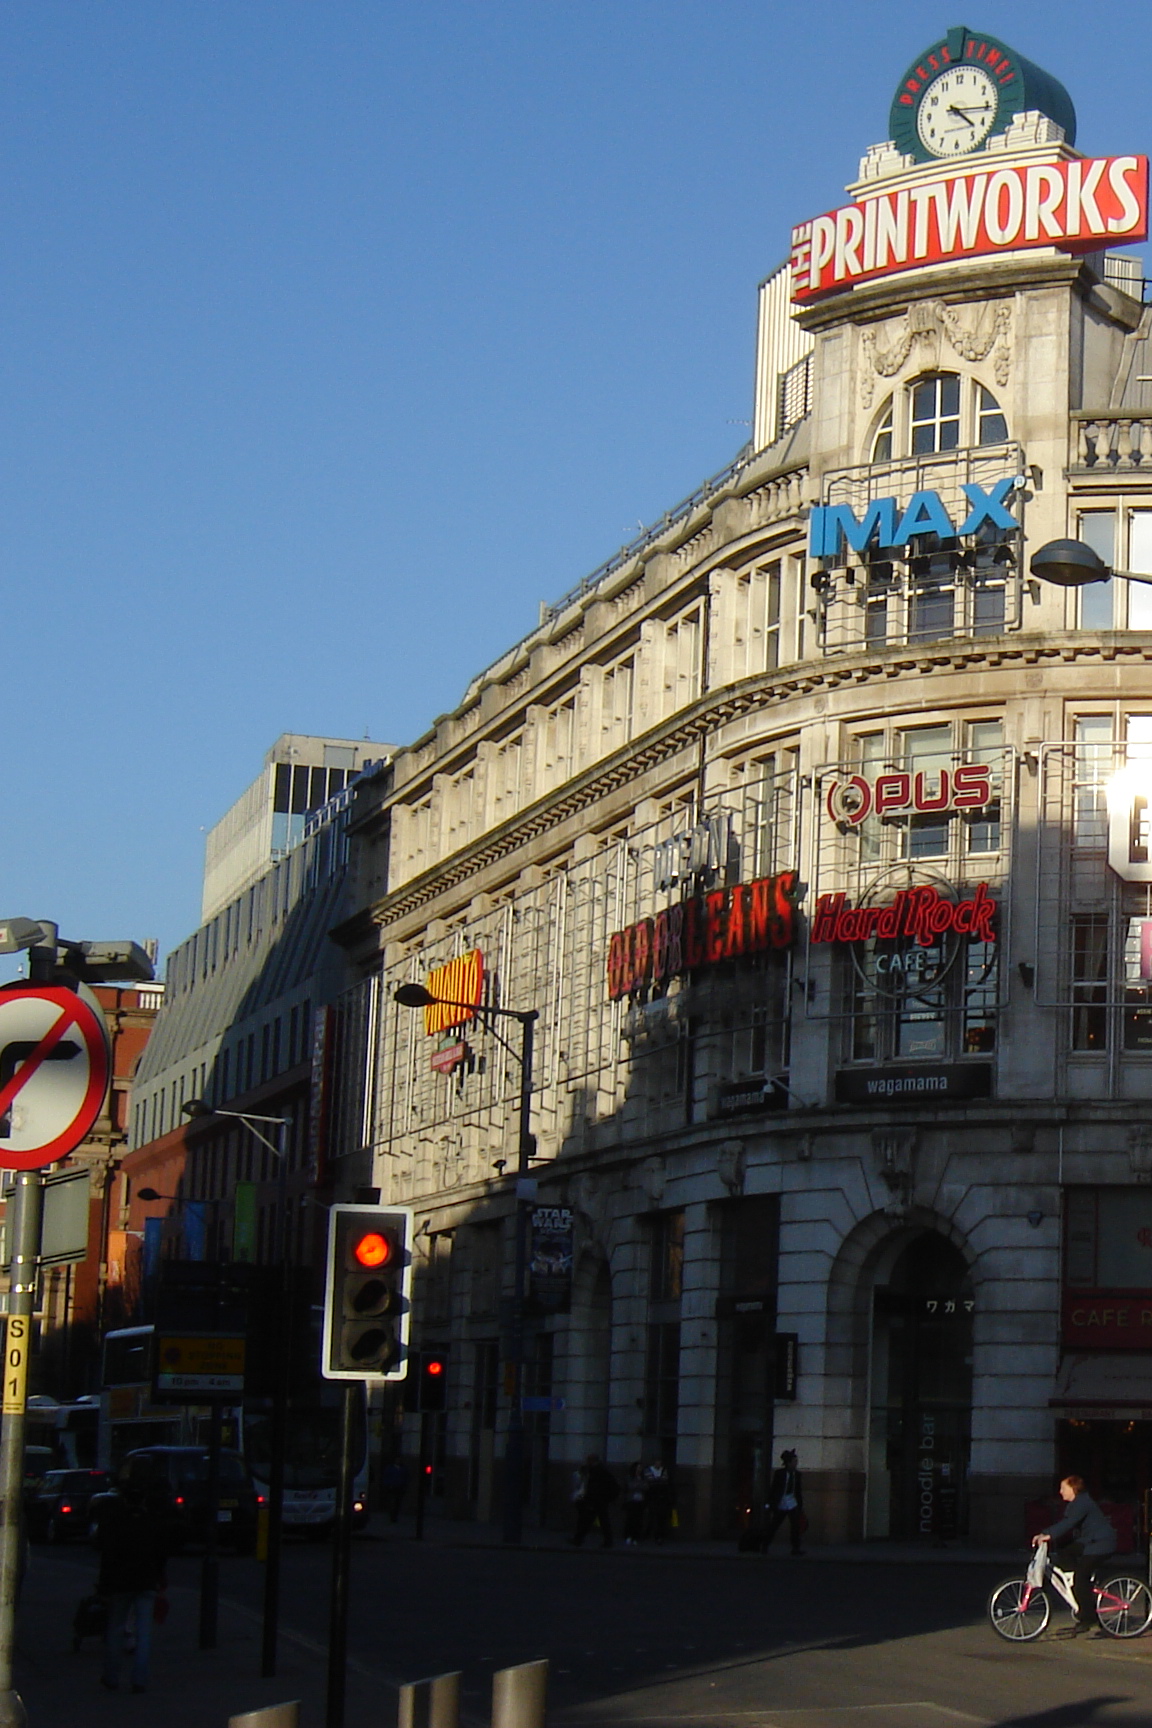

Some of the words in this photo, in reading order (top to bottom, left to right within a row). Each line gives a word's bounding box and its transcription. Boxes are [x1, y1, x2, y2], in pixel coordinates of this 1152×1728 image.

[900, 46, 950, 105] PRESS
[809, 156, 1140, 290] PRINTWORKS
[810, 477, 1020, 557] IMAX
[827, 765, 992, 825] OPUS
[811, 890, 907, 943] Hard
[905, 884, 996, 947] Rock
[867, 1076, 947, 1096] wagamama
